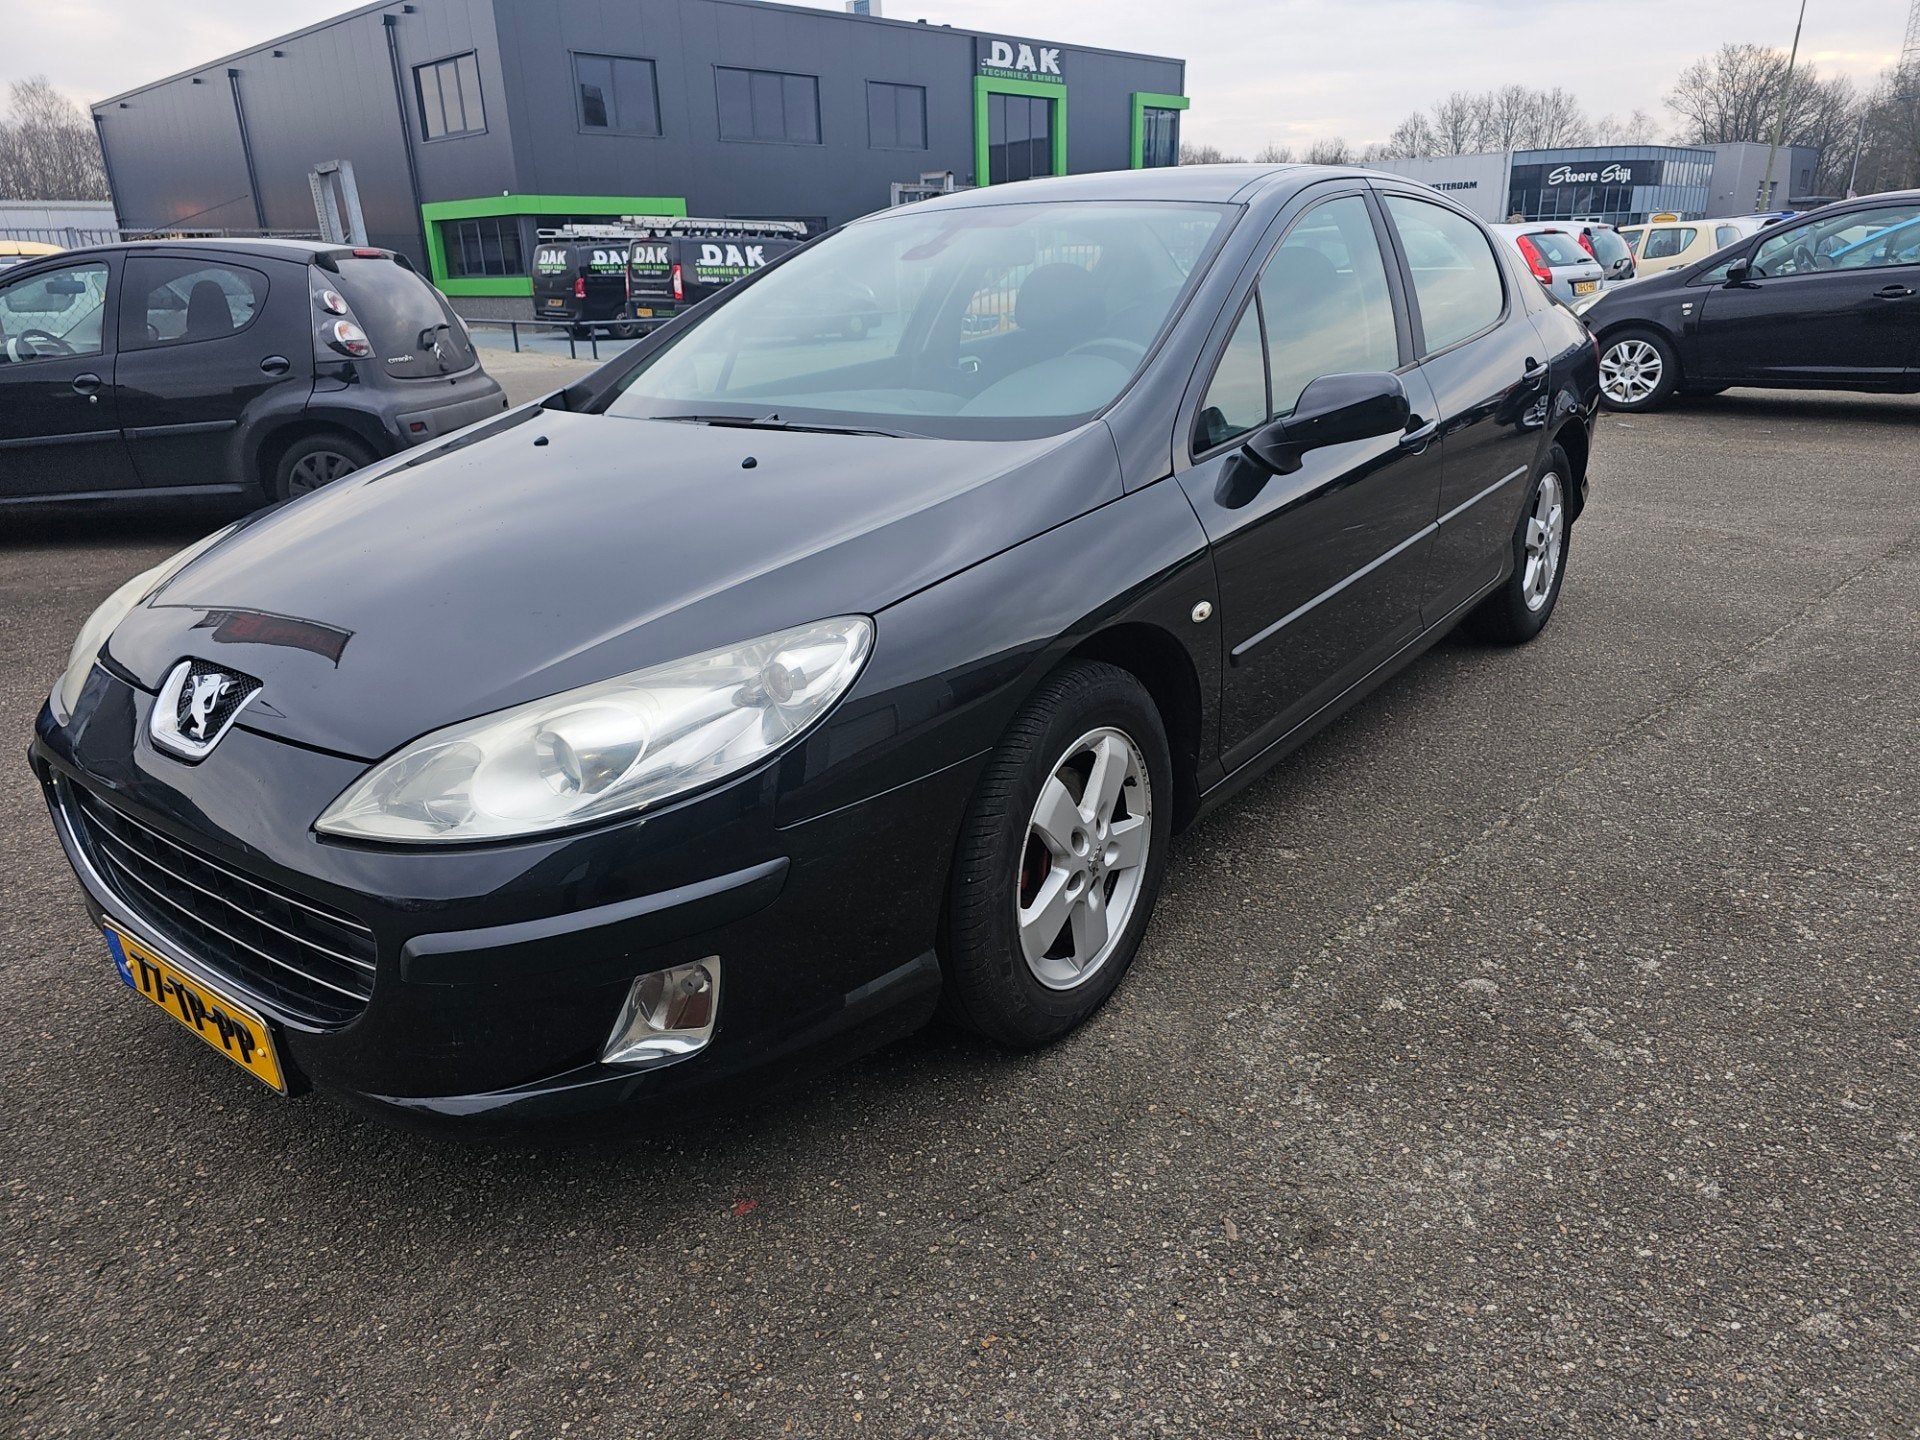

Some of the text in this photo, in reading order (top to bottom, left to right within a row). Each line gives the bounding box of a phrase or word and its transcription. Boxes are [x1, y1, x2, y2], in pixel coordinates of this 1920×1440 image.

[982, 41, 1060, 74] DAK
[981, 68, 1029, 80] TECHNIEK
[1548, 164, 1631, 185] Stoere Stijl
[538, 250, 567, 264] DAK
[633, 246, 668, 264] DAK
[695, 244, 766, 267] DAK
[696, 267, 740, 275] TECHNIEK
[129, 950, 256, 1064] 77-TP-PP
